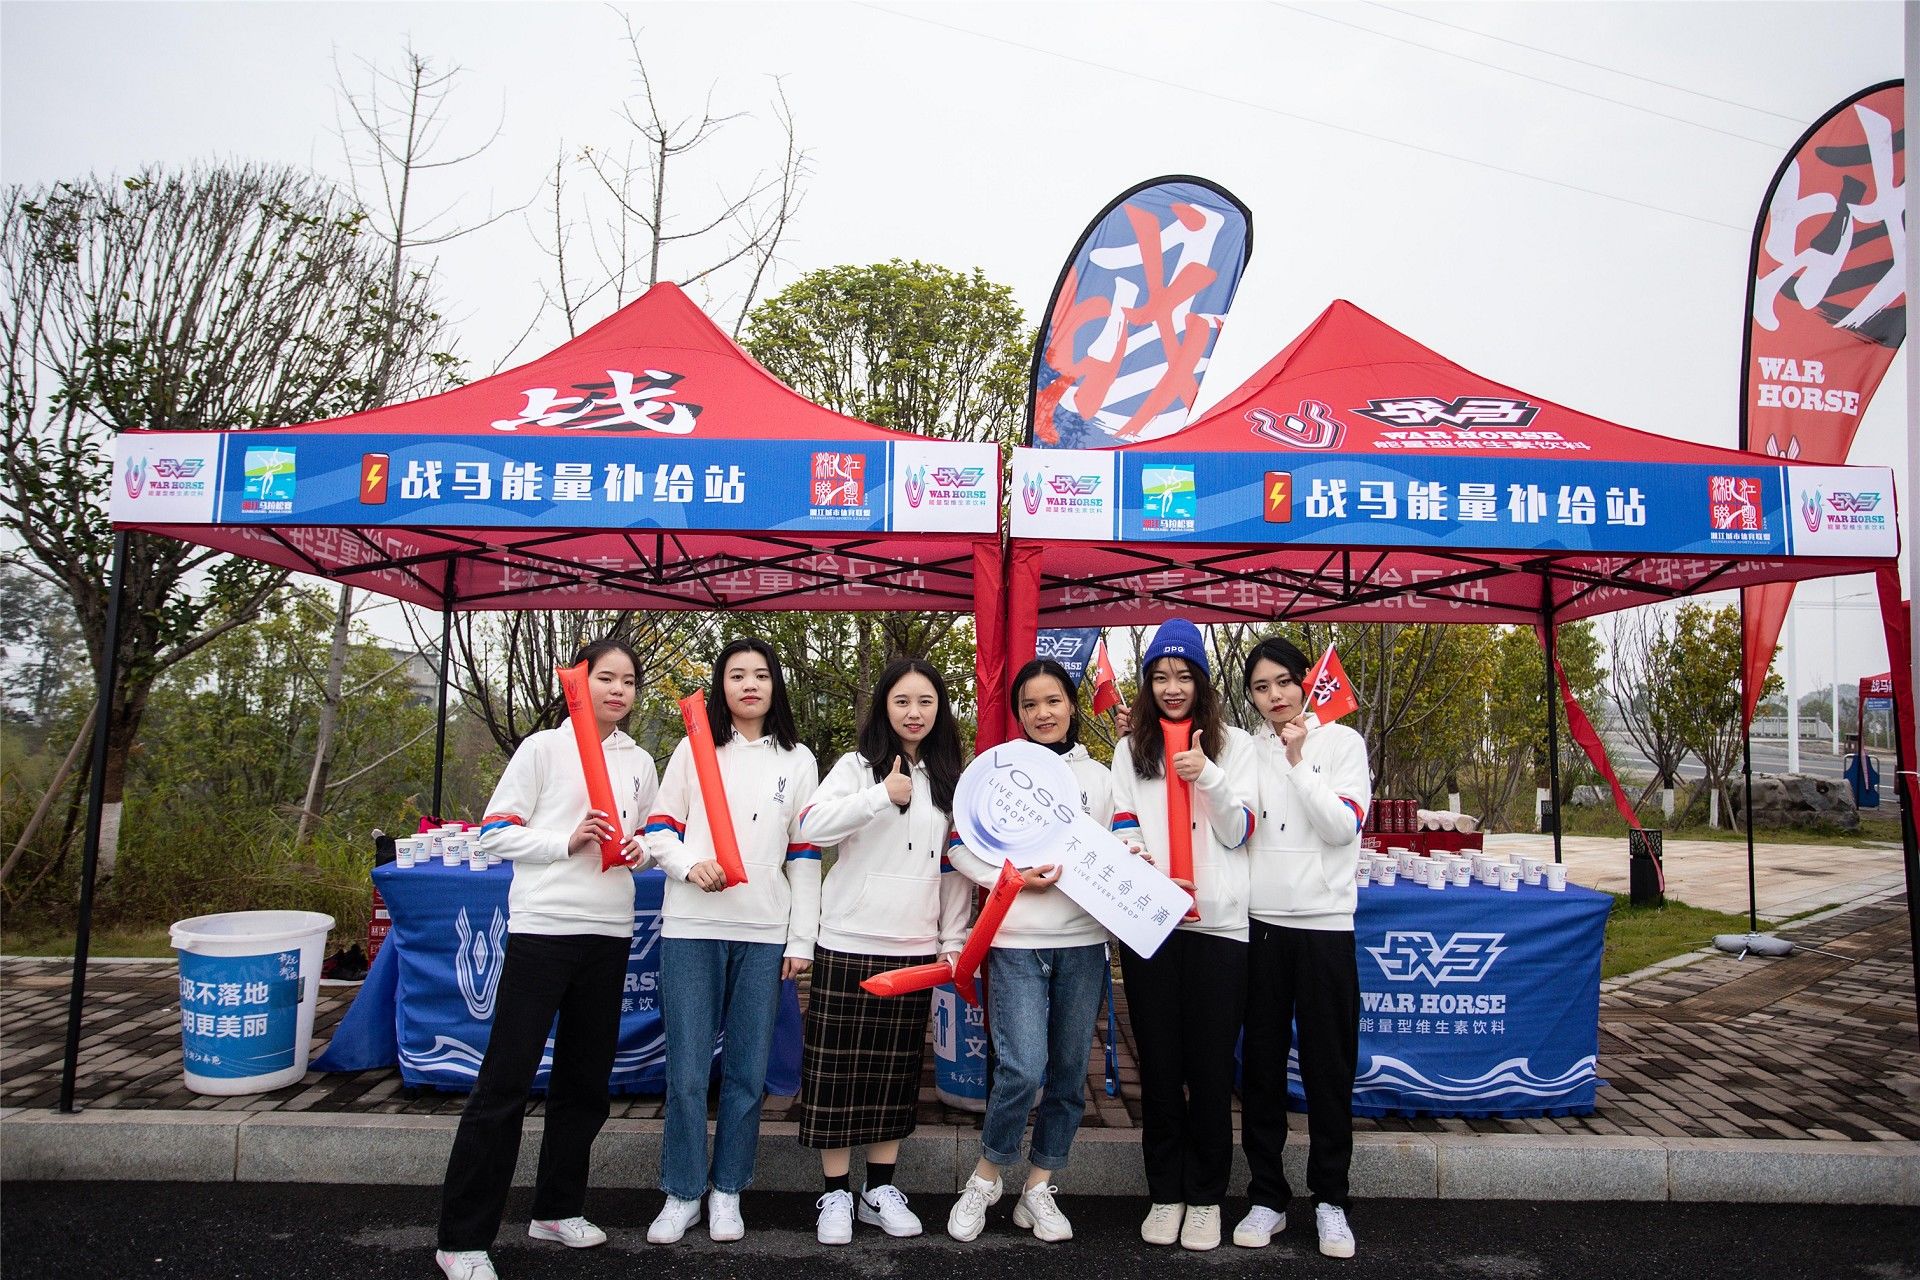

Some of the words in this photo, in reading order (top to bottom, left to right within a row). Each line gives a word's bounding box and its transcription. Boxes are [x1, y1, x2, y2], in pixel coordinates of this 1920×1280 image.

[1758, 357, 1825, 384] WAR
[1757, 384, 1860, 416] HORSE
[1380, 431, 1452, 440] WAR
[1453, 431, 1564, 441] HORSE
[150, 482, 170, 490] WAR
[171, 482, 205, 490] HORSE
[400, 460, 746, 504] 战马能量补给站
[929, 490, 950, 498] WAR
[952, 490, 986, 498] HORSE
[1046, 497, 1067, 506] WAR
[1069, 498, 1103, 507] HORSE
[1305, 479, 1646, 526] 战马能量补给站
[1827, 515, 1848, 523] WAR
[1850, 515, 1884, 523] HORSE
[989, 777, 1013, 800] LIVE
[1015, 799, 1050, 828] EVERY
[1065, 836, 1171, 927] 不负生命点滴
[1073, 866, 1092, 882] LIVE
[1091, 881, 1116, 902] EVERY
[1360, 992, 1416, 1014] WAR
[1420, 993, 1507, 1015] HORSE
[1359, 1017, 1507, 1035] 能量型维生素饮料
